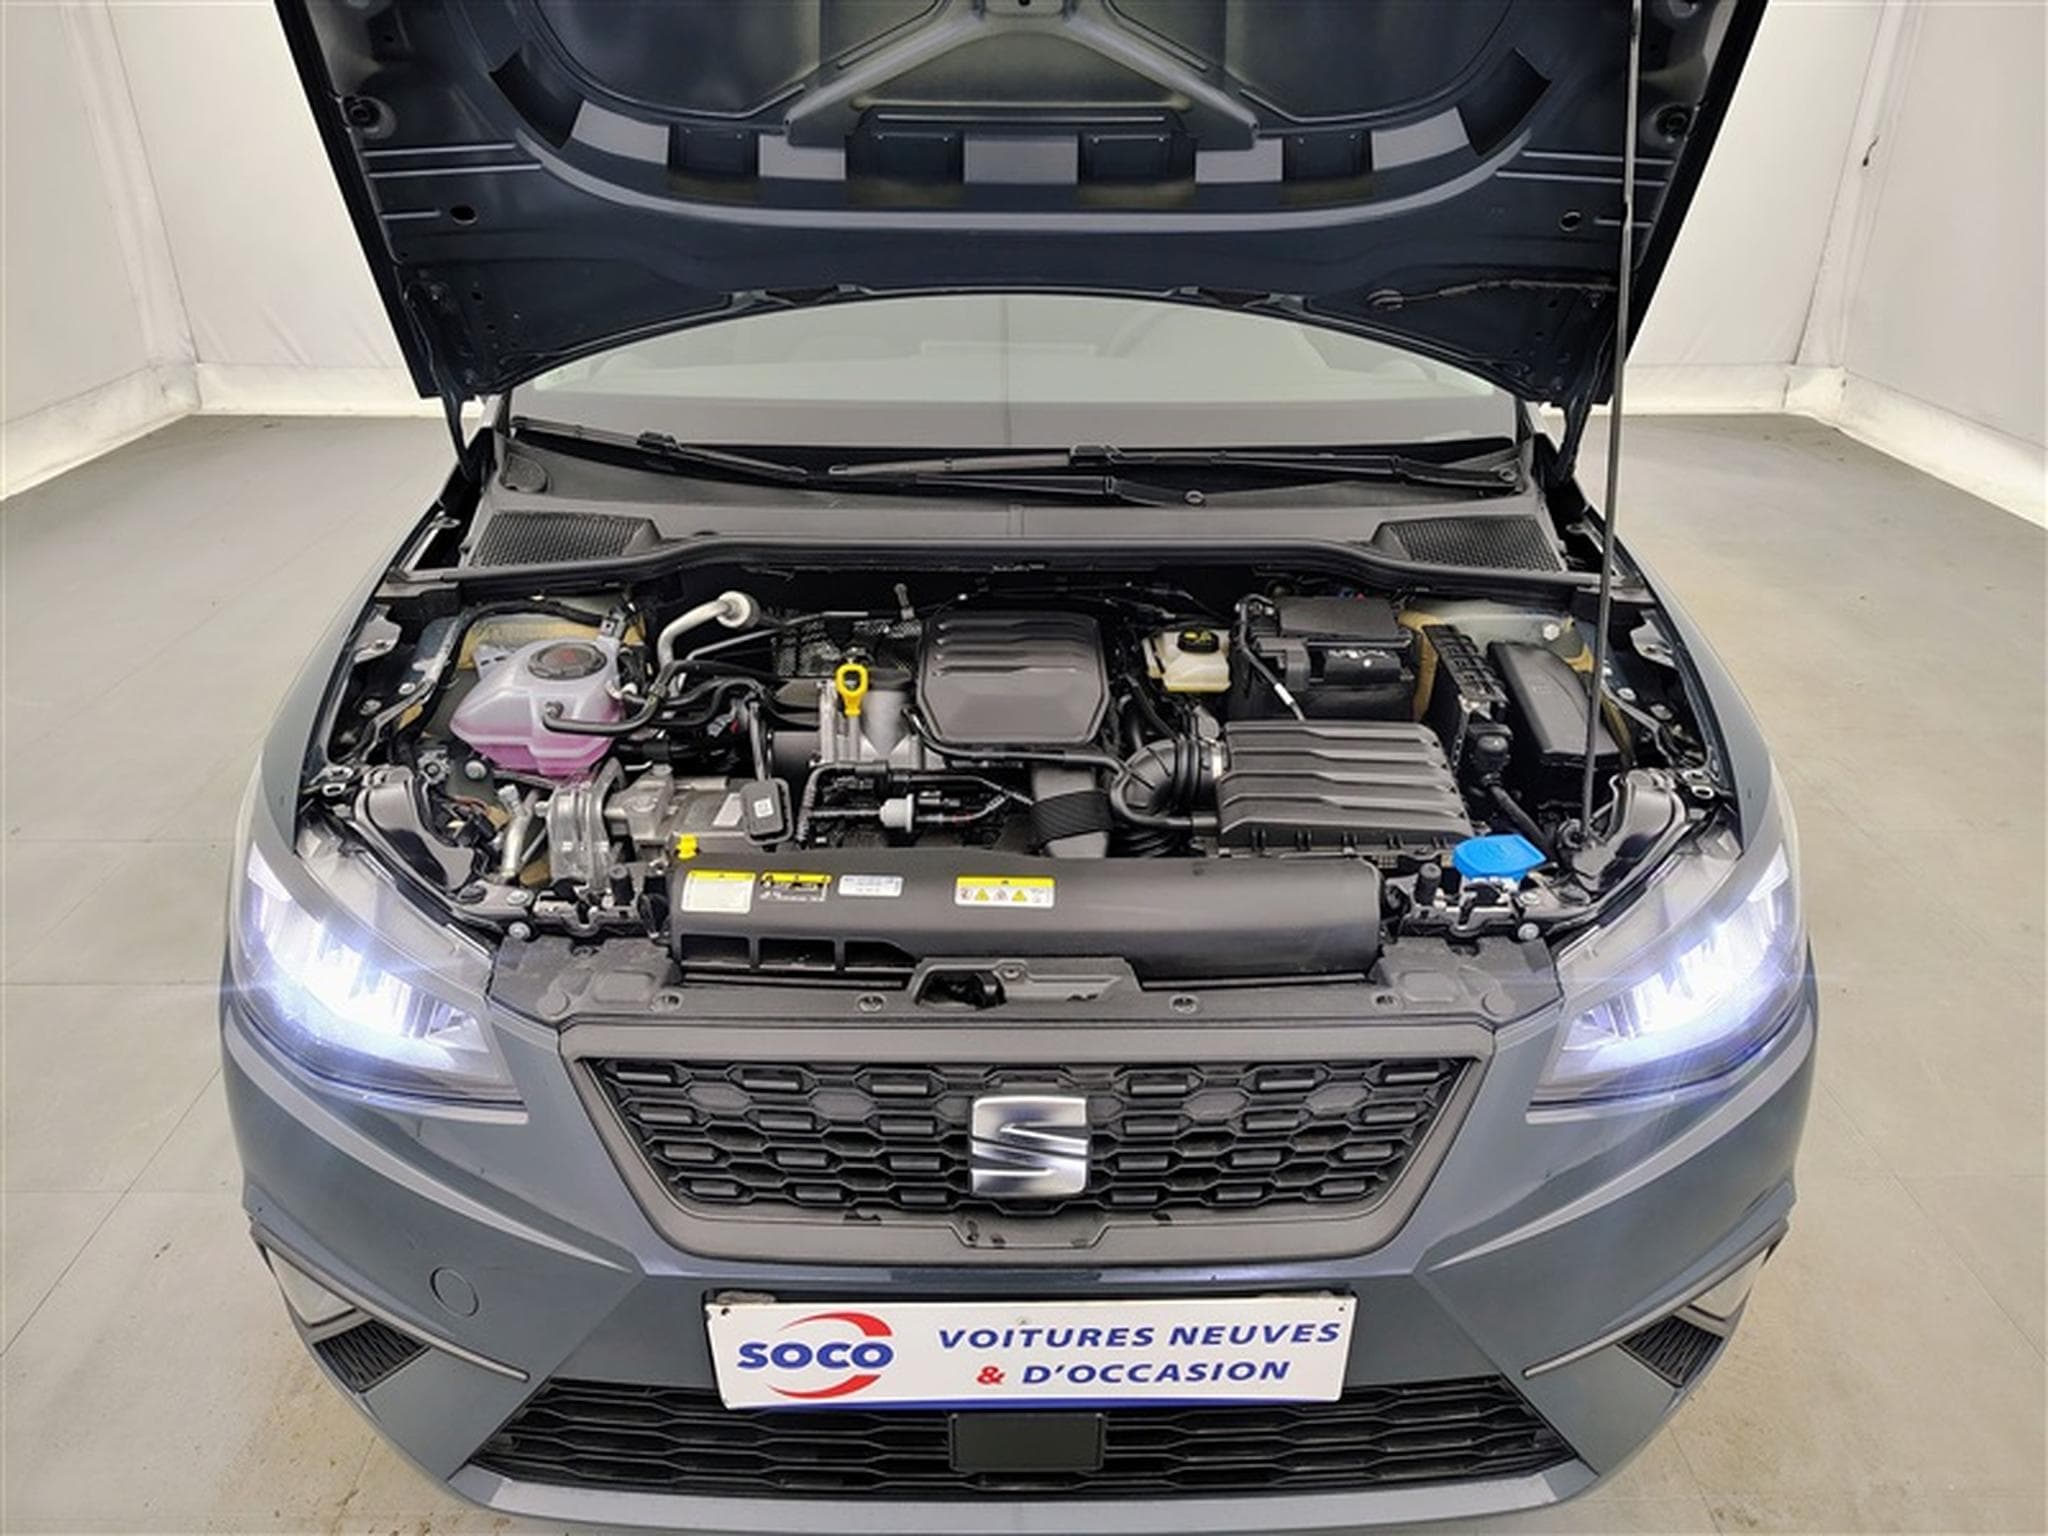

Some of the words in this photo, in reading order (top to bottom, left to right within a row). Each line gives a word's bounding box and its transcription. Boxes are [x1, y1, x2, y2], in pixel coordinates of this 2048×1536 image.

[938, 1326, 1155, 1348] VOITURES
[1169, 1323, 1341, 1346] NEUVES
[737, 1341, 895, 1370] SOCO
[976, 1364, 1006, 1386] &
[1022, 1360, 1292, 1384] D'OCCASION
